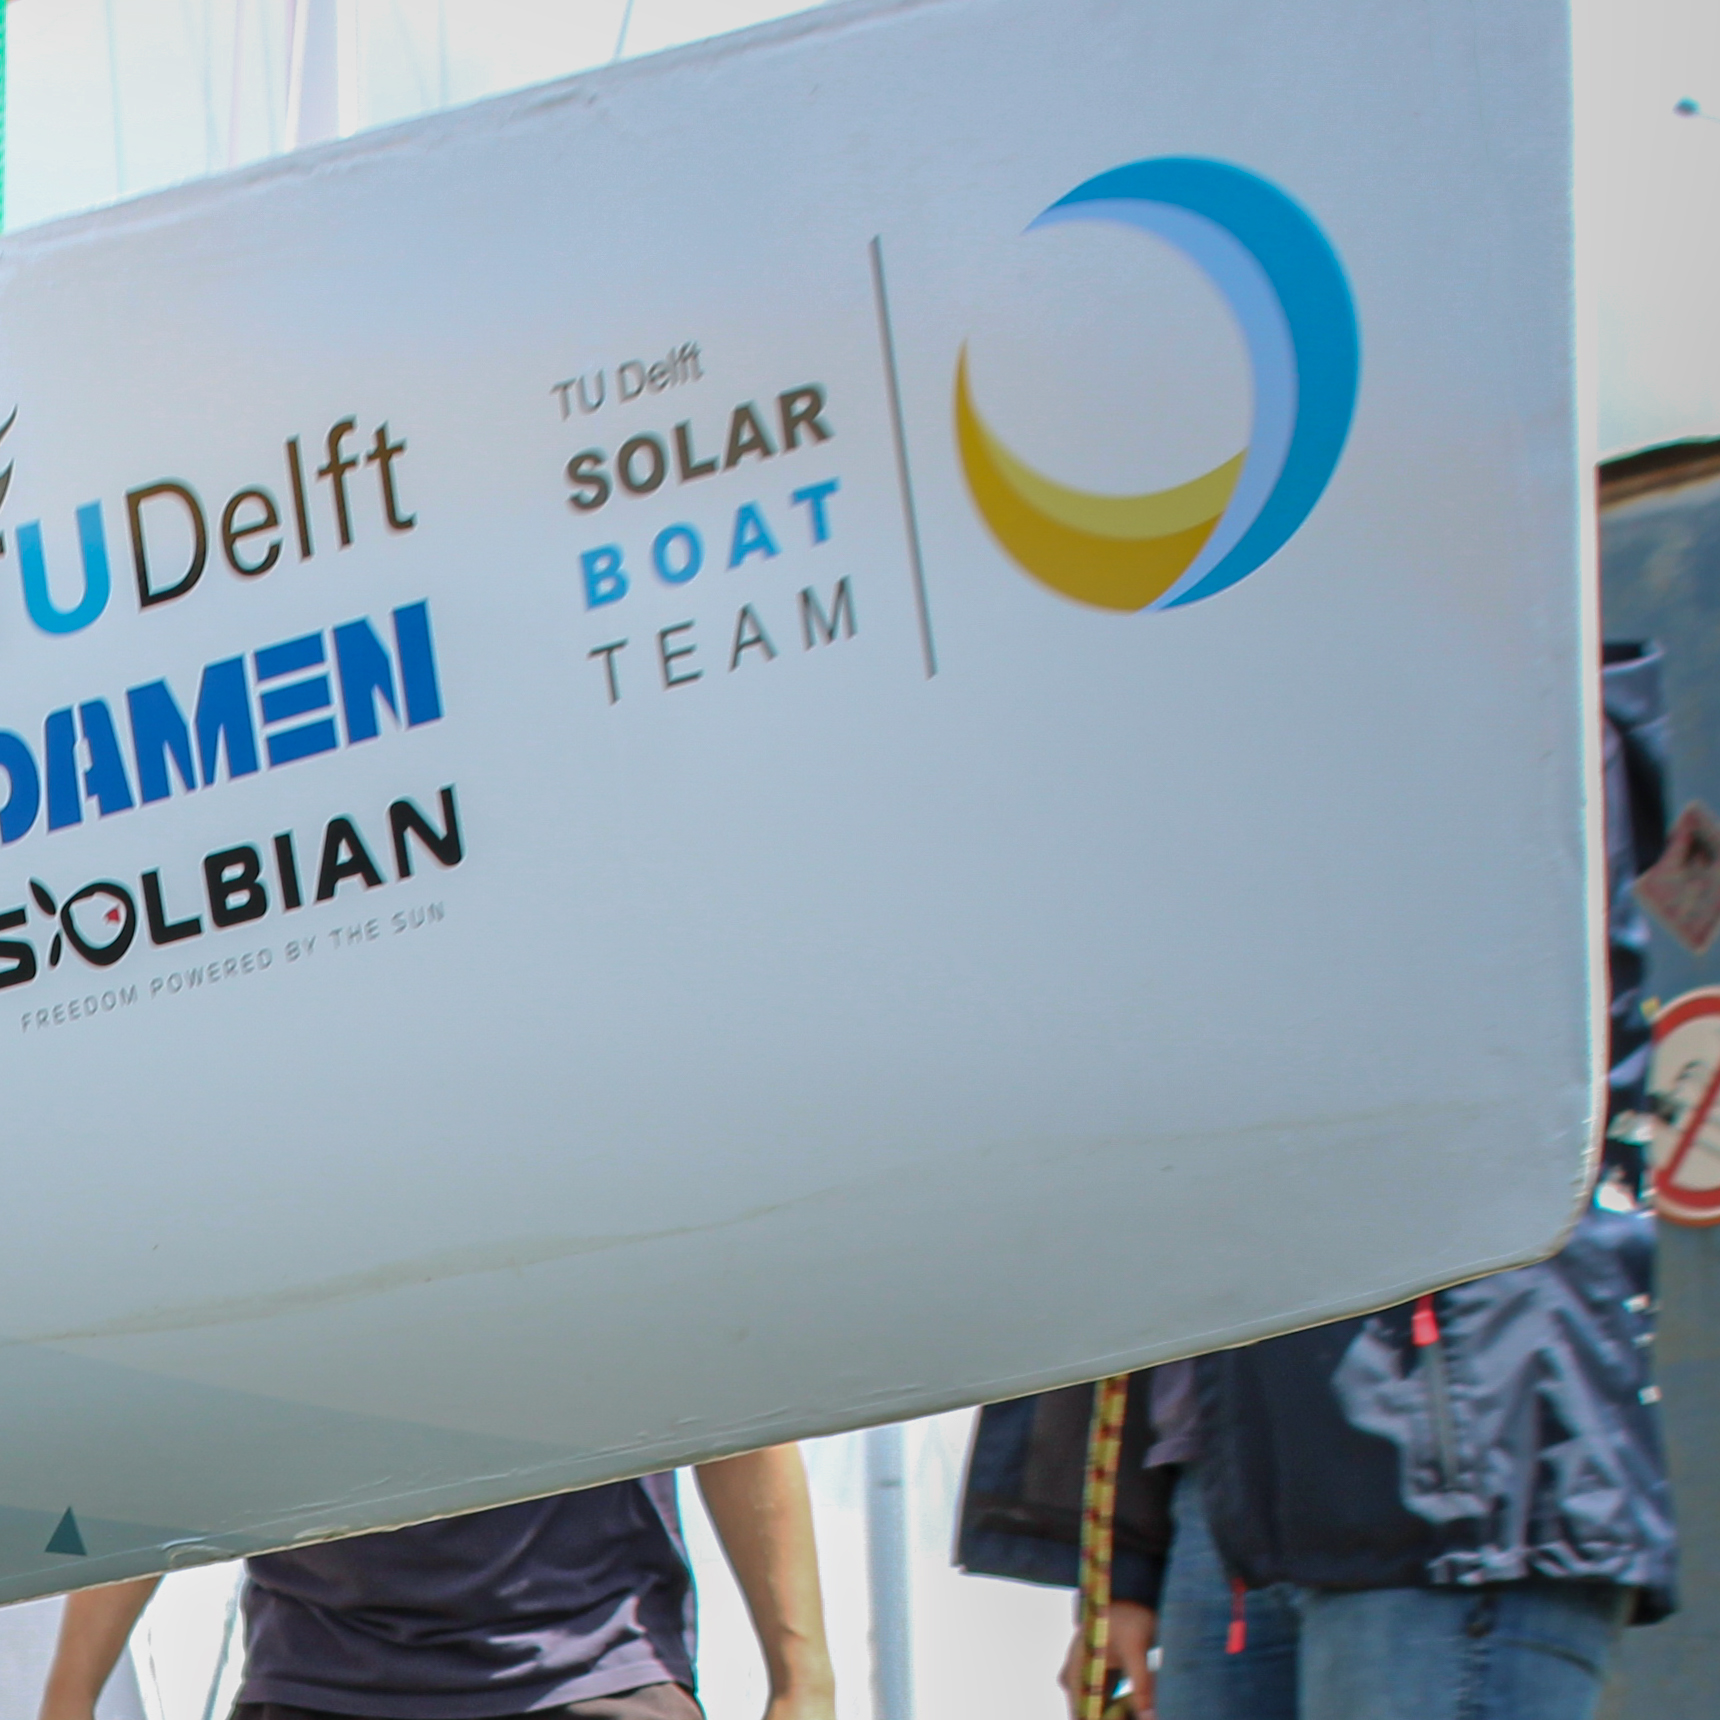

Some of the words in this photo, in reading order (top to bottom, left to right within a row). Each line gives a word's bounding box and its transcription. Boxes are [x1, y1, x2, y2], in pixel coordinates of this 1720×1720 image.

[550, 368, 607, 422] TU
[616, 340, 705, 404] Delft
[565, 381, 836, 515] SOLAR
[579, 476, 842, 613] BOAT
[586, 573, 859, 706] TEAM
[19, 984, 139, 1033] FREEDOM
[149, 947, 273, 996] POWERED
[285, 935, 318, 963] BY
[329, 918, 380, 951] THE
[391, 900, 446, 934] SUN
